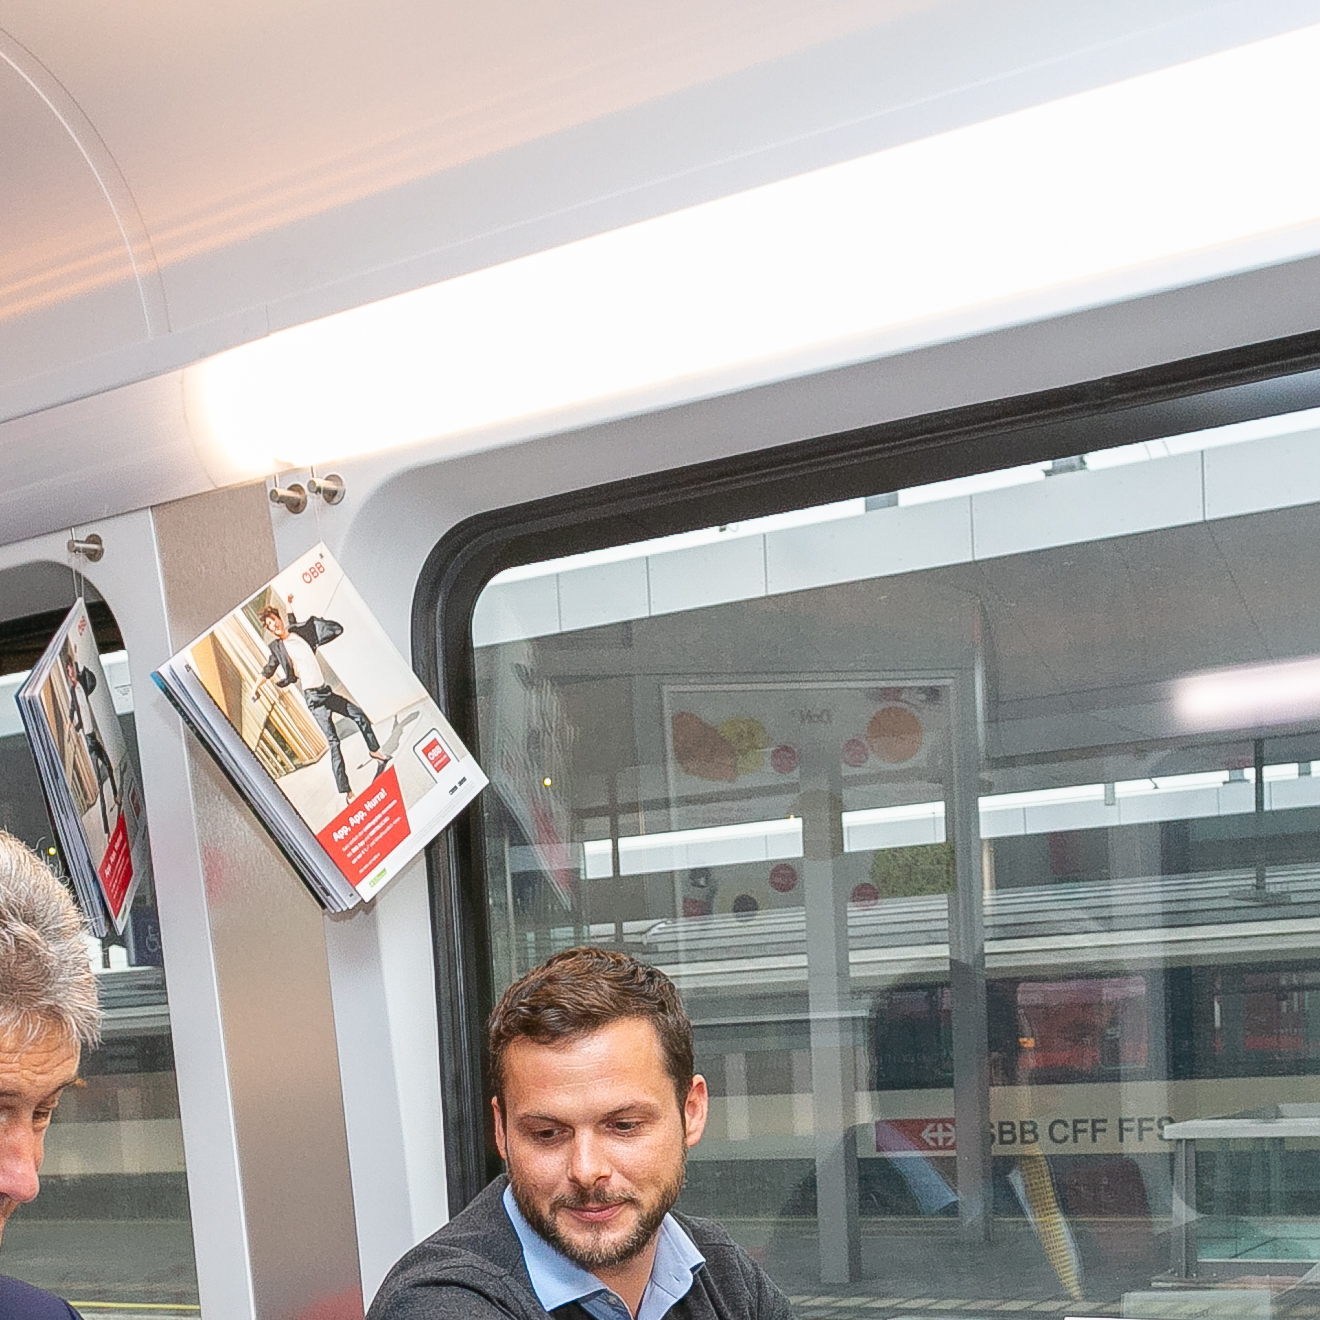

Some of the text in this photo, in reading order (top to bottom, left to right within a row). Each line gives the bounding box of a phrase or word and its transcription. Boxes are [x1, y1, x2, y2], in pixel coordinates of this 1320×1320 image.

[302, 561, 326, 584] ÖBB
[332, 825, 351, 842] App,
[349, 811, 367, 827] App,
[364, 788, 388, 812] Hurra!
[1048, 1118, 1108, 1143] CFF
